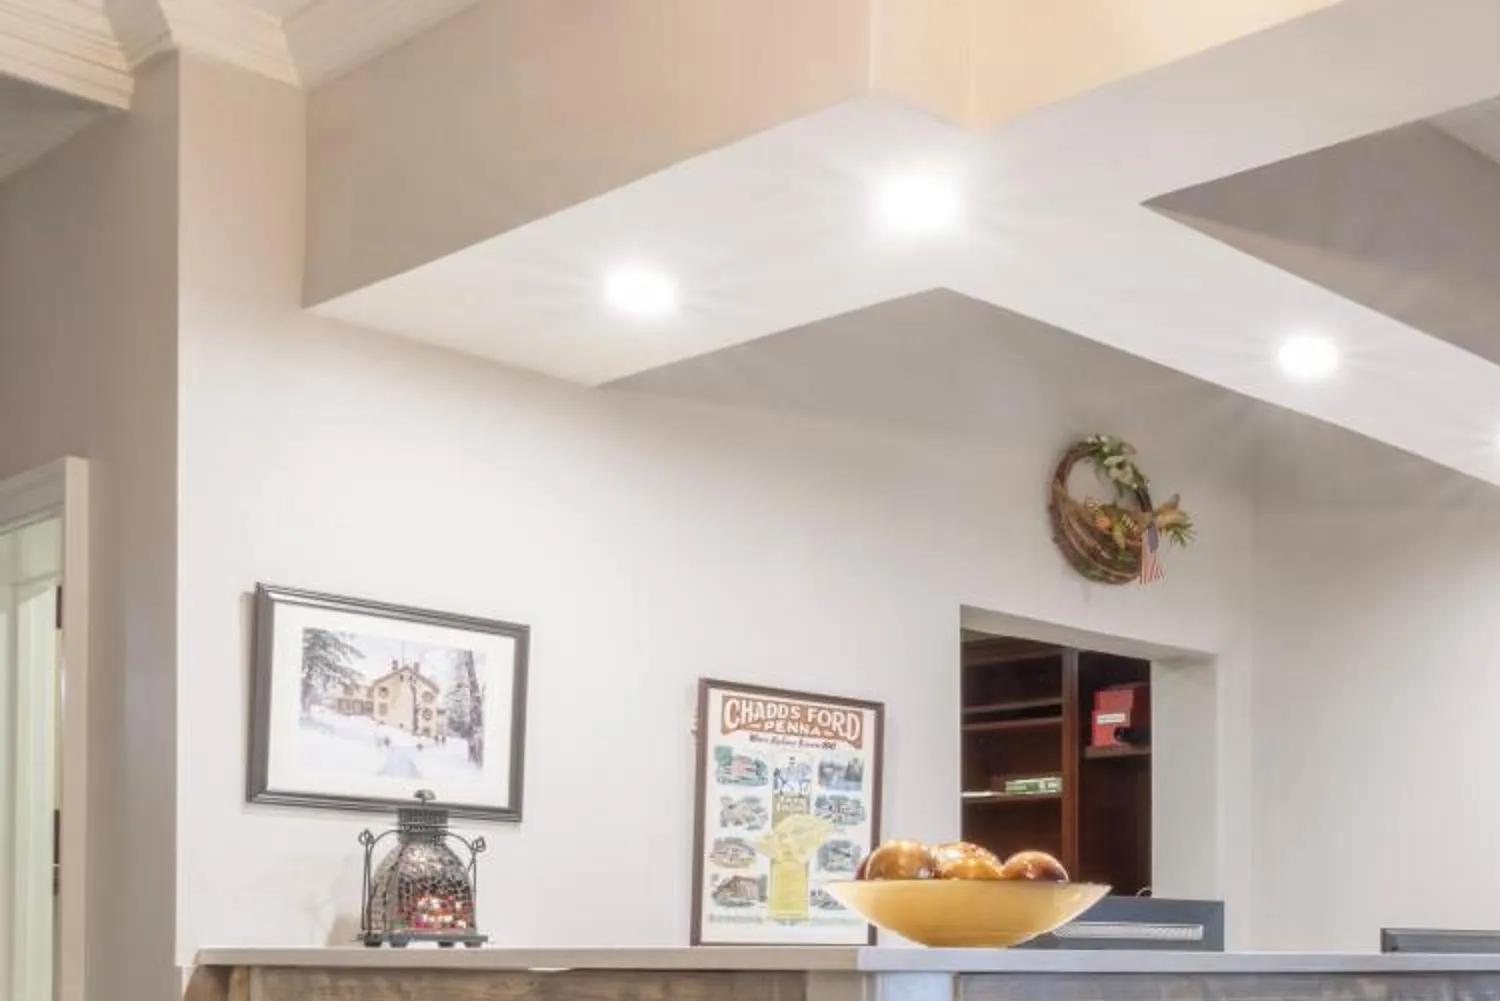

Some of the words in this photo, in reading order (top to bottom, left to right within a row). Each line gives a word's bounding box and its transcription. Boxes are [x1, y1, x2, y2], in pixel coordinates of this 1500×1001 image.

[724, 698, 801, 729] CHADDS
[807, 706, 860, 740] FORD
[763, 720, 821, 737] PENNA
